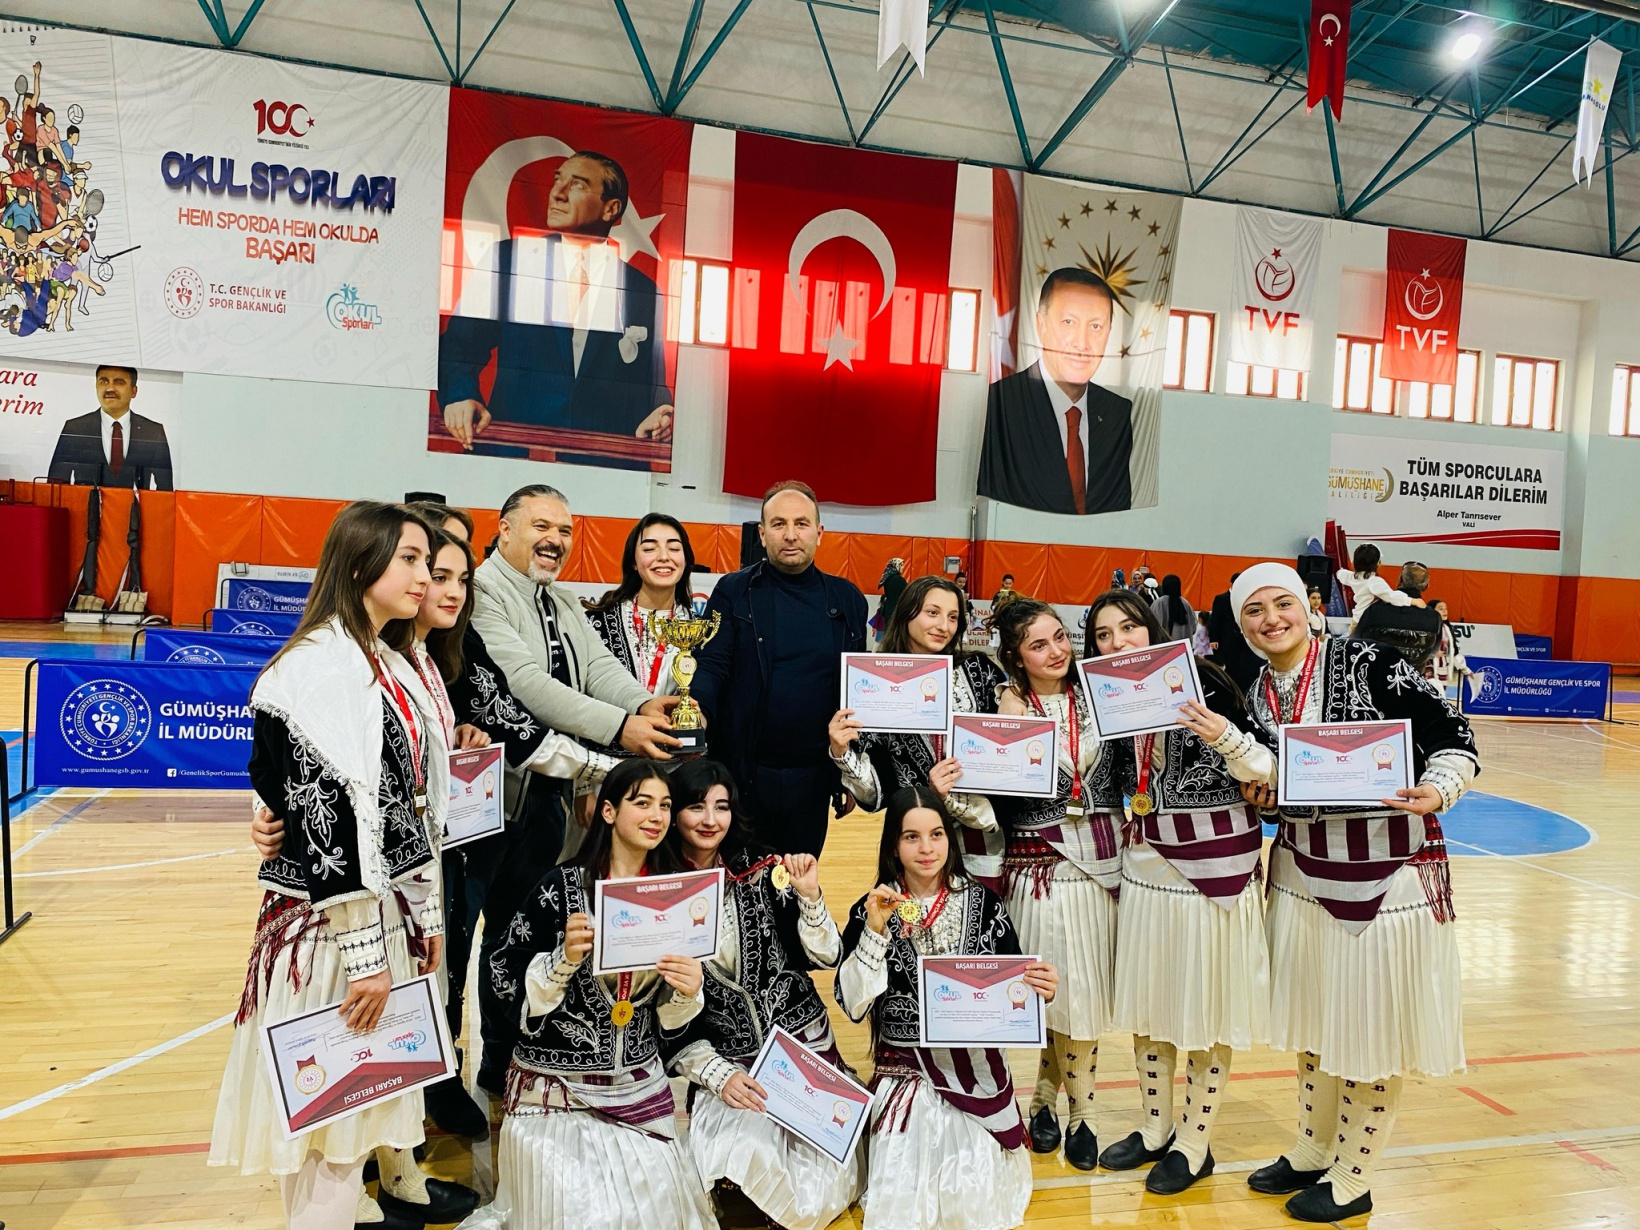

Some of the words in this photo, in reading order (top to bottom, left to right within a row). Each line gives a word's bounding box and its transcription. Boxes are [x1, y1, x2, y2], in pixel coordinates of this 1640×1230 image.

[161, 151, 247, 195] OKUL
[249, 161, 396, 210] SPORLARI
[178, 207, 213, 228] HEM
[216, 211, 280, 235] SPORDA
[283, 218, 316, 239] HEM
[319, 223, 380, 244] OKULDA
[246, 237, 316, 265] BAŞARI
[210, 283, 227, 295] T.C.
[229, 284, 271, 300] GENÇLİK
[274, 289, 286, 300] VE
[209, 297, 234, 309] SPOR
[236, 299, 286, 314] BAKANLIĞI
[334, 301, 382, 325] OKUL
[1244, 305, 1300, 337] TVF
[1396, 324, 1448, 354] TVF
[1407, 456, 1440, 477] TÜM
[1444, 462, 1542, 484] SPORCULARA
[1399, 480, 1485, 501] BAŞARILAR
[1489, 483, 1548, 504] DİLERİM
[1437, 509, 1459, 520] Alper
[1460, 511, 1501, 521] Tanrısever
[875, 660, 893, 668] BAŞARI
[1112, 657, 1130, 667] BAŞARI
[1130, 654, 1151, 664] BELGESİ
[1504, 684, 1510, 694] İL
[1510, 685, 1552, 696] MÜDÜRLÜĞÜ
[1505, 675, 1548, 687] GÜMÜŞHANE
[1548, 678, 1574, 688] GENÇLİK
[1583, 680, 1601, 688] SPOR
[158, 722, 174, 740] İL
[955, 962, 976, 970] BAŞARI
[976, 962, 999, 970] BELGESİ
[800, 1053, 817, 1070] BAŞARI
[817, 1065, 837, 1082] BELGESİ
[376, 1076, 403, 1091] BAŞARI
[344, 1086, 375, 1105] BELGESİ
